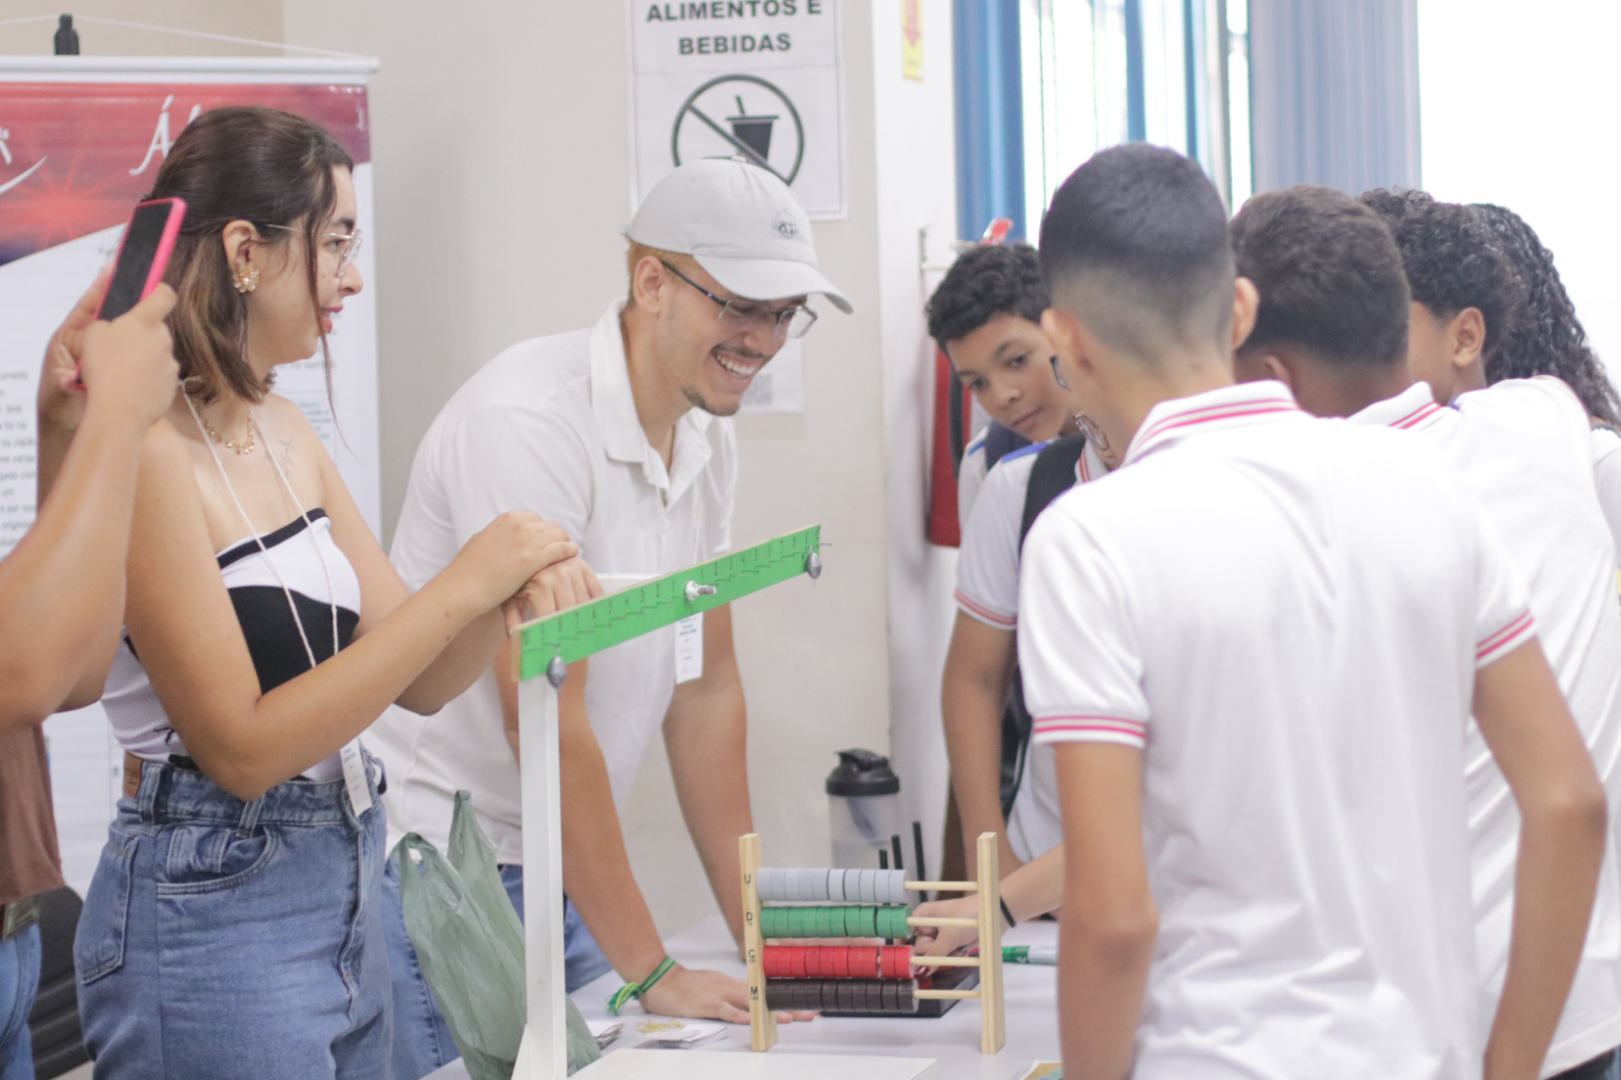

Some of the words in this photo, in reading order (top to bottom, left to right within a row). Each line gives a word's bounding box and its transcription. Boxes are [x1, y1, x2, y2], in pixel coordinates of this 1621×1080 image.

[647, 0, 797, 21] ALIMENTOS
[807, 0, 822, 14] E
[679, 33, 791, 55] BEBIDAS
[744, 874, 751, 884] U
[746, 911, 753, 922] D
[748, 948, 756, 959] C
[750, 986, 758, 996] M
